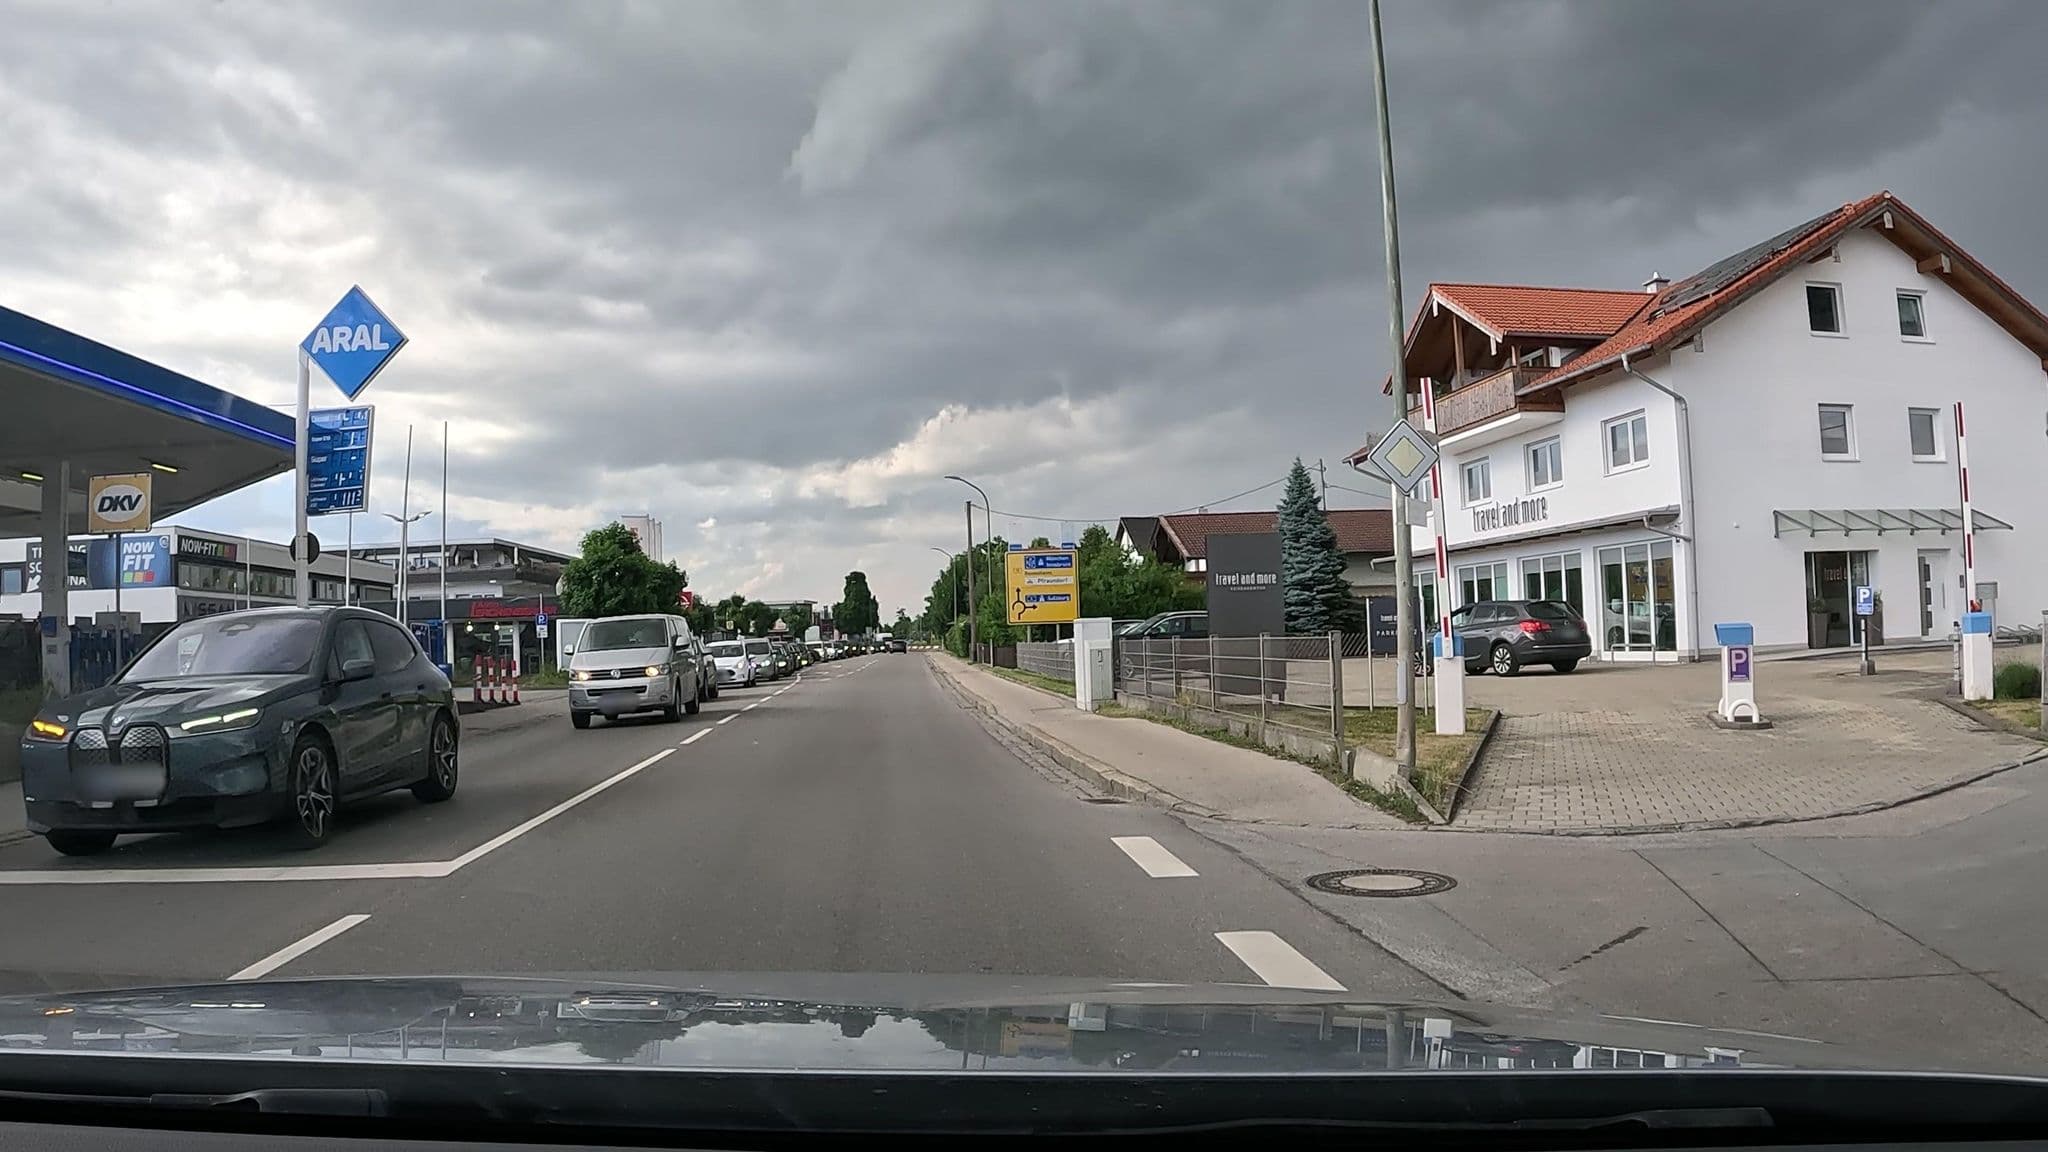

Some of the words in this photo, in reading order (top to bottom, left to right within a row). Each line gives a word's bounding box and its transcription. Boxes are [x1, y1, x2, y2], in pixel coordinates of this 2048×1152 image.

[311, 323, 390, 354] ARAL
[98, 494, 143, 513] DKV
[1472, 501, 1500, 532] travel
[1502, 496, 1519, 527] and
[1521, 496, 1548, 523] more
[123, 541, 154, 554] NOW
[181, 538, 218, 556] NOW-FIT
[123, 554, 155, 571] FIT
[1215, 573, 1239, 585] travel
[1241, 572, 1255, 585] and
[1256, 574, 1277, 585] more
[1860, 589, 1870, 603] P
[1731, 650, 1748, 672] P
